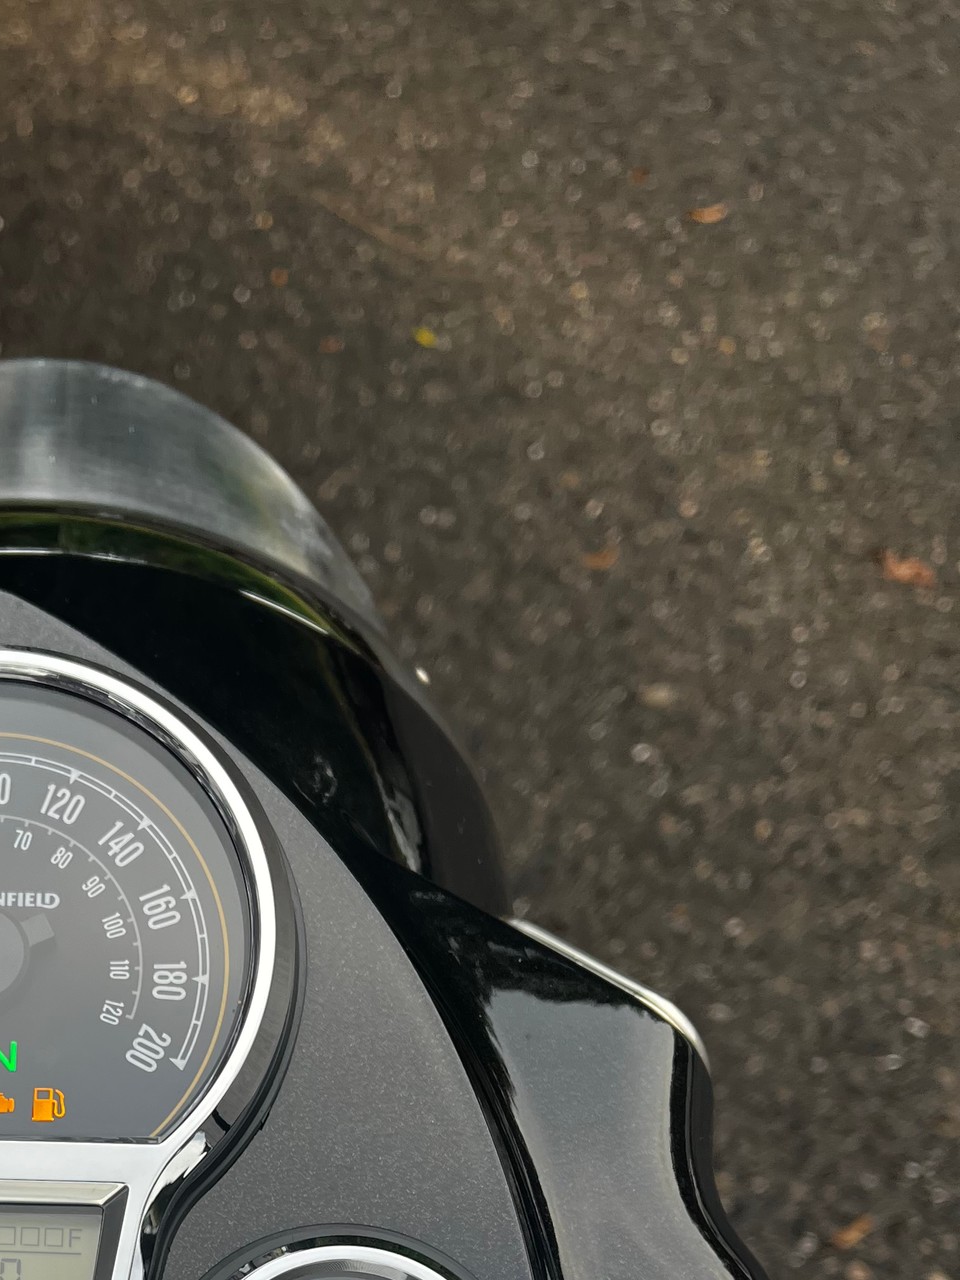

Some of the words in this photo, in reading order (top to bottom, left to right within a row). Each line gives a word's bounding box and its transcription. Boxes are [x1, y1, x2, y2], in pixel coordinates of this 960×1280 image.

[40, 783, 85, 825] 120
[13, 829, 33, 851] 70
[97, 820, 145, 867] 140
[50, 846, 73, 869] 80
[81, 875, 106, 898] 90
[139, 884, 181, 930] 160
[101, 912, 127, 939] 100
[109, 959, 130, 980] 110
[152, 961, 187, 1001] 180
[99, 999, 124, 1025] 120
[125, 1023, 172, 1073] 200
[68, 1228, 83, 1248] F
